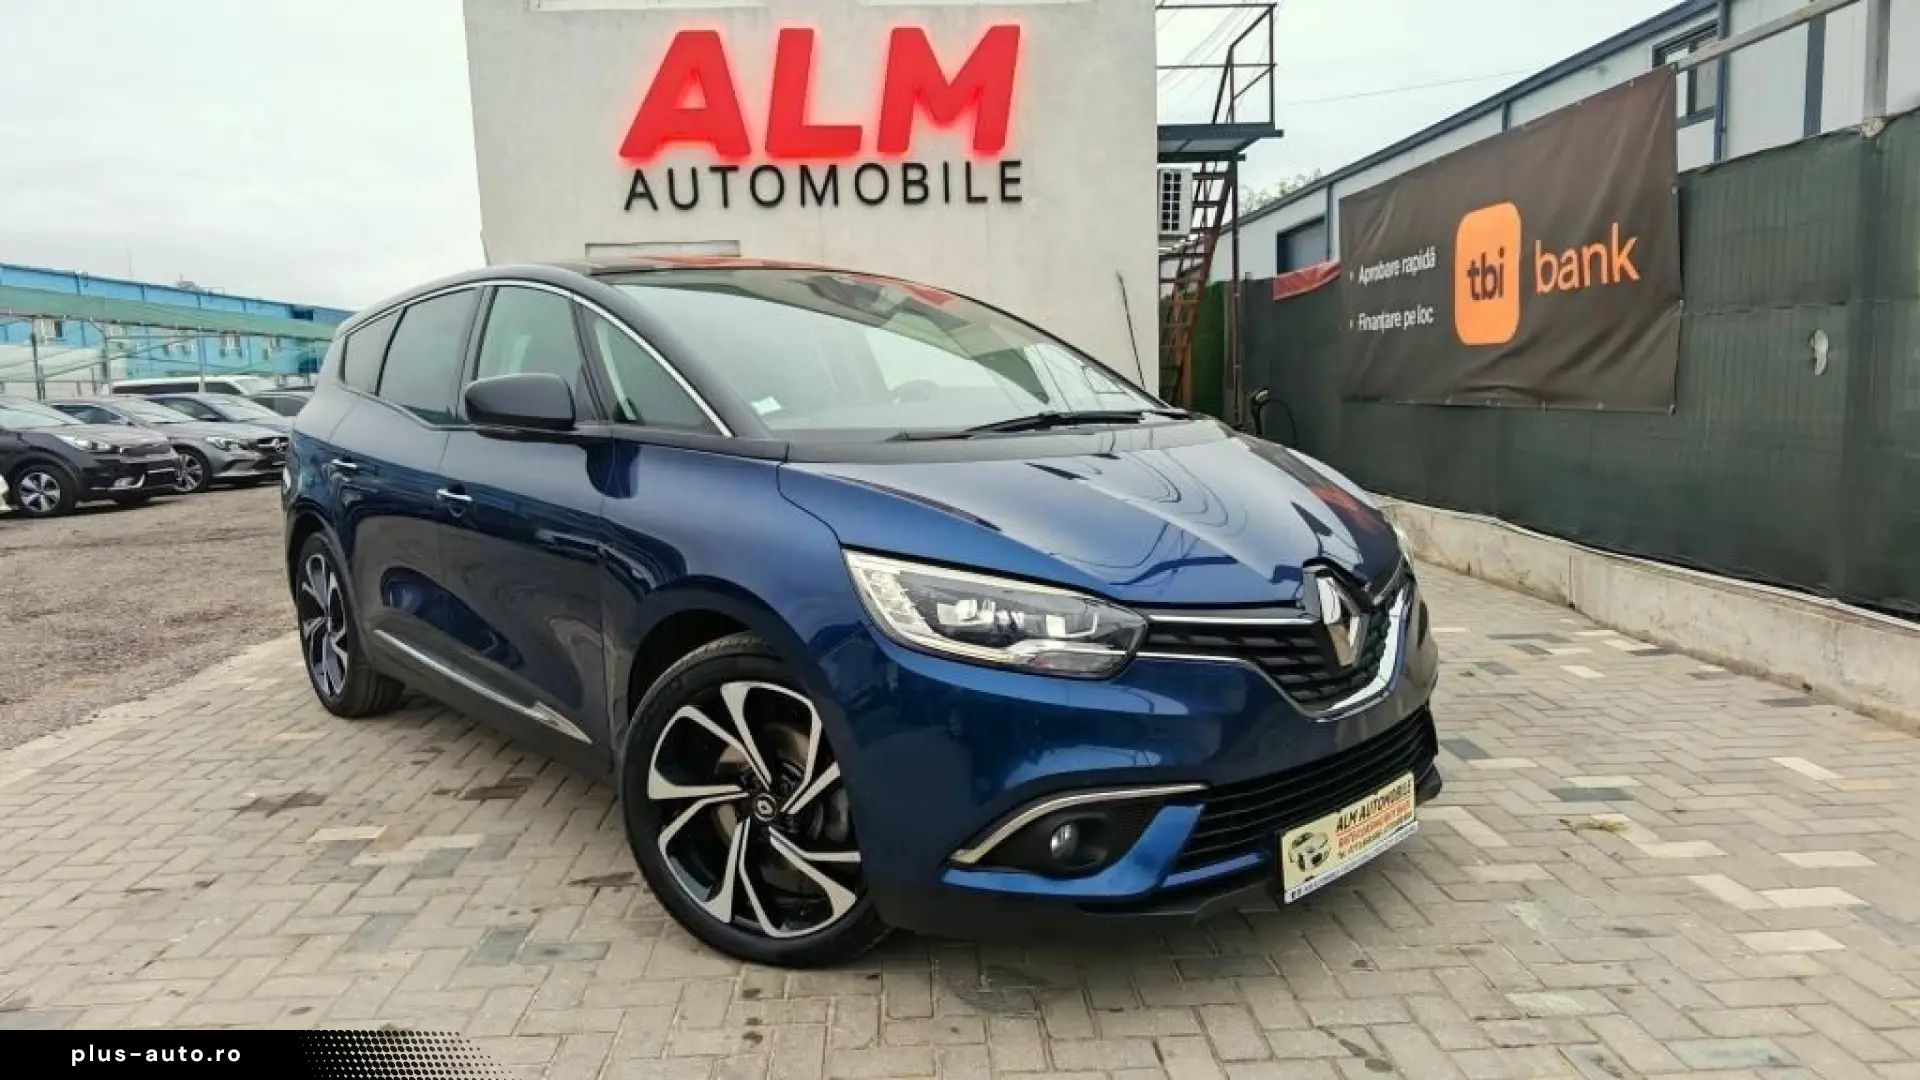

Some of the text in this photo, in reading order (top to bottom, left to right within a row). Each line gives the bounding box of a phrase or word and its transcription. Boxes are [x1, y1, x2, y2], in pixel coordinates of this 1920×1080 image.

[619, 24, 1020, 158] ALM
[624, 160, 1022, 211] AUTOMOBILE
[1358, 259, 1400, 286] Aprobare
[1467, 222, 1640, 301] tbi bank
[1404, 310, 1416, 330] pe
[1417, 304, 1434, 325] loc
